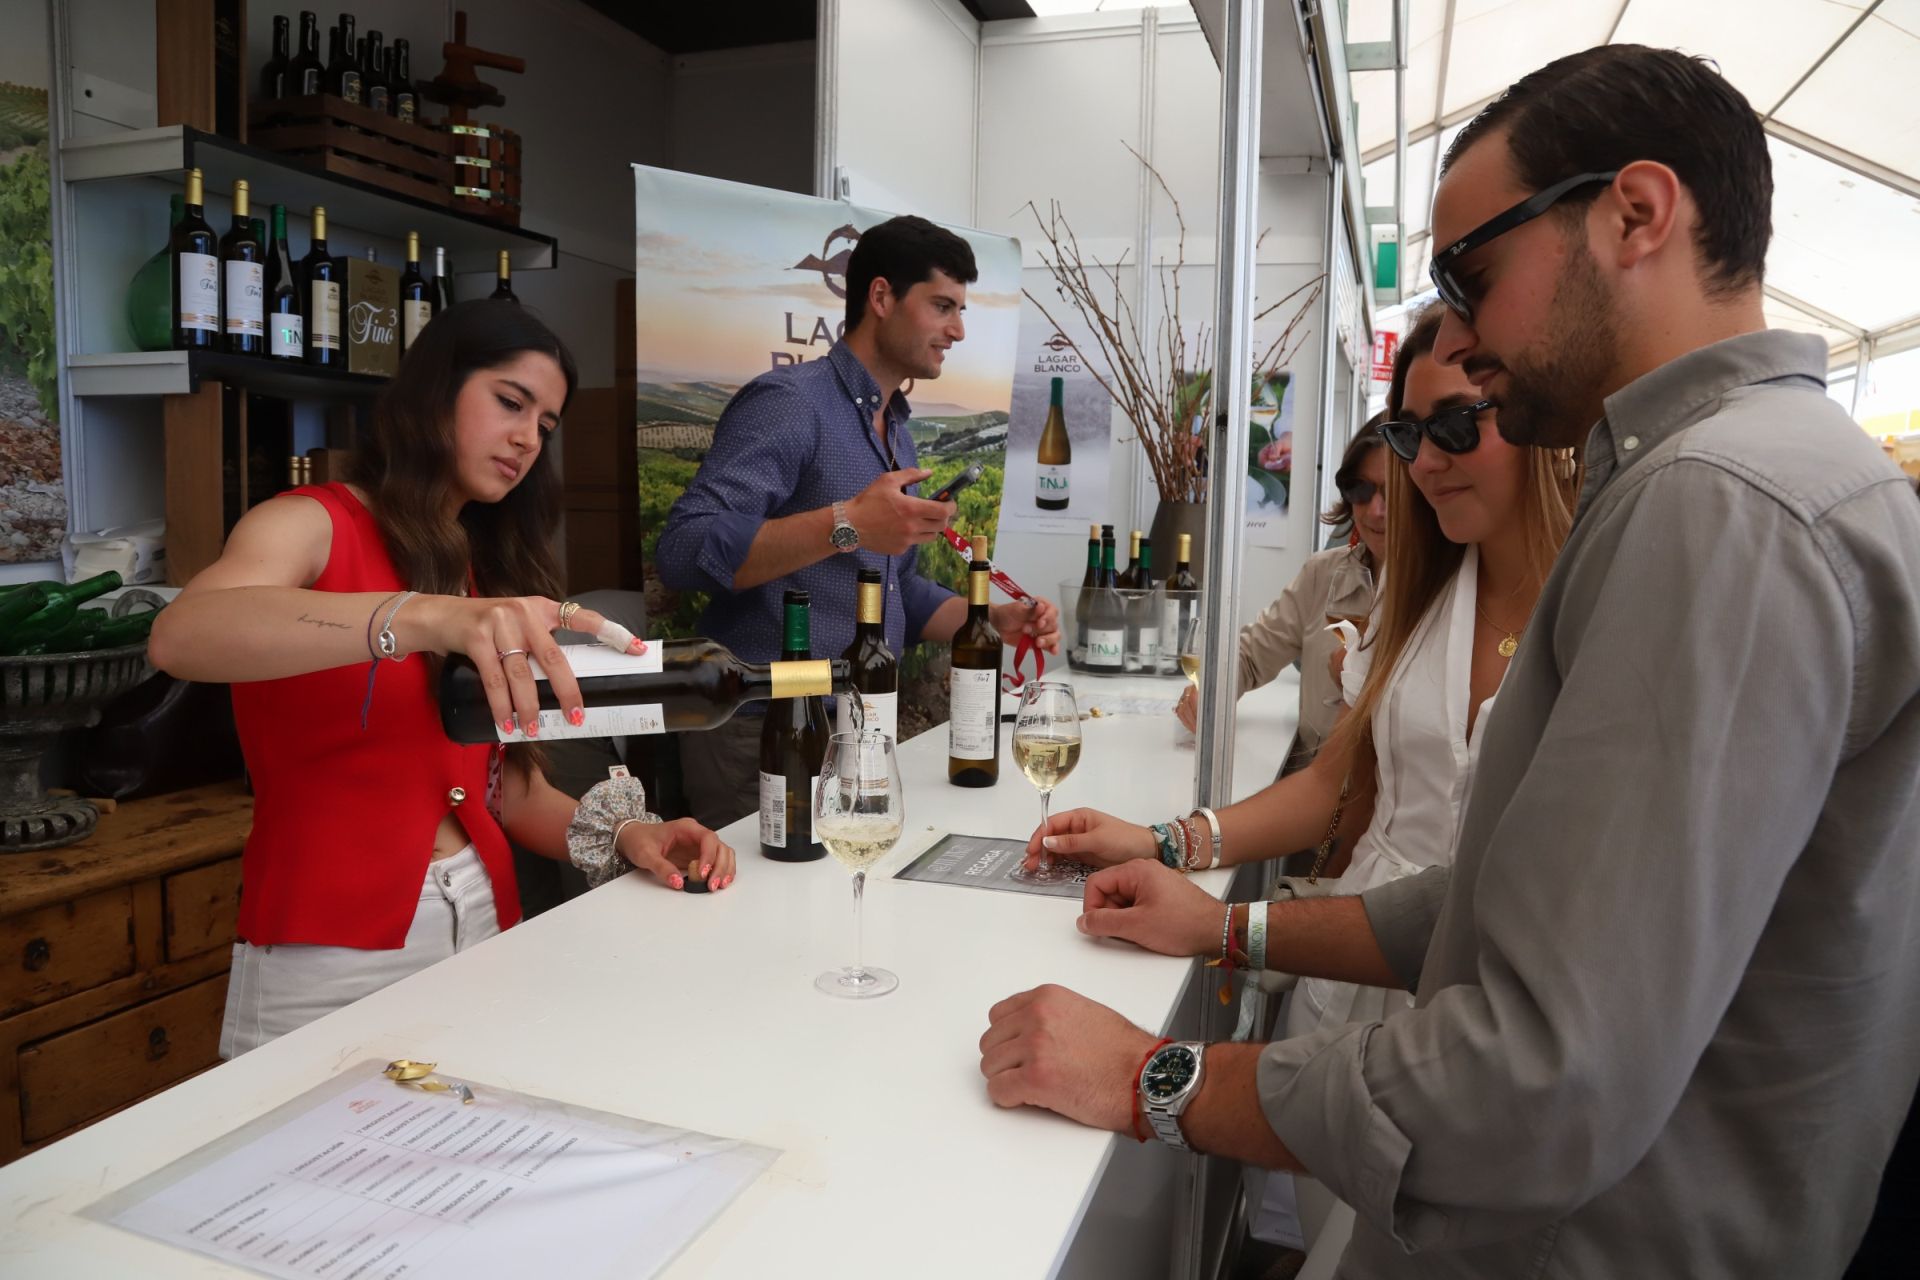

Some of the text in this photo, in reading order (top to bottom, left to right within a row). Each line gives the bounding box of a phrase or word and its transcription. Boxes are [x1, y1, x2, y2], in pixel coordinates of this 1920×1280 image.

[348, 301, 395, 345] Fino
[388, 308, 397, 327] 3
[1034, 364, 1081, 373] BLANCO
[1038, 355, 1078, 364] LAGAR
[965, 849, 1003, 877] RECARGA
